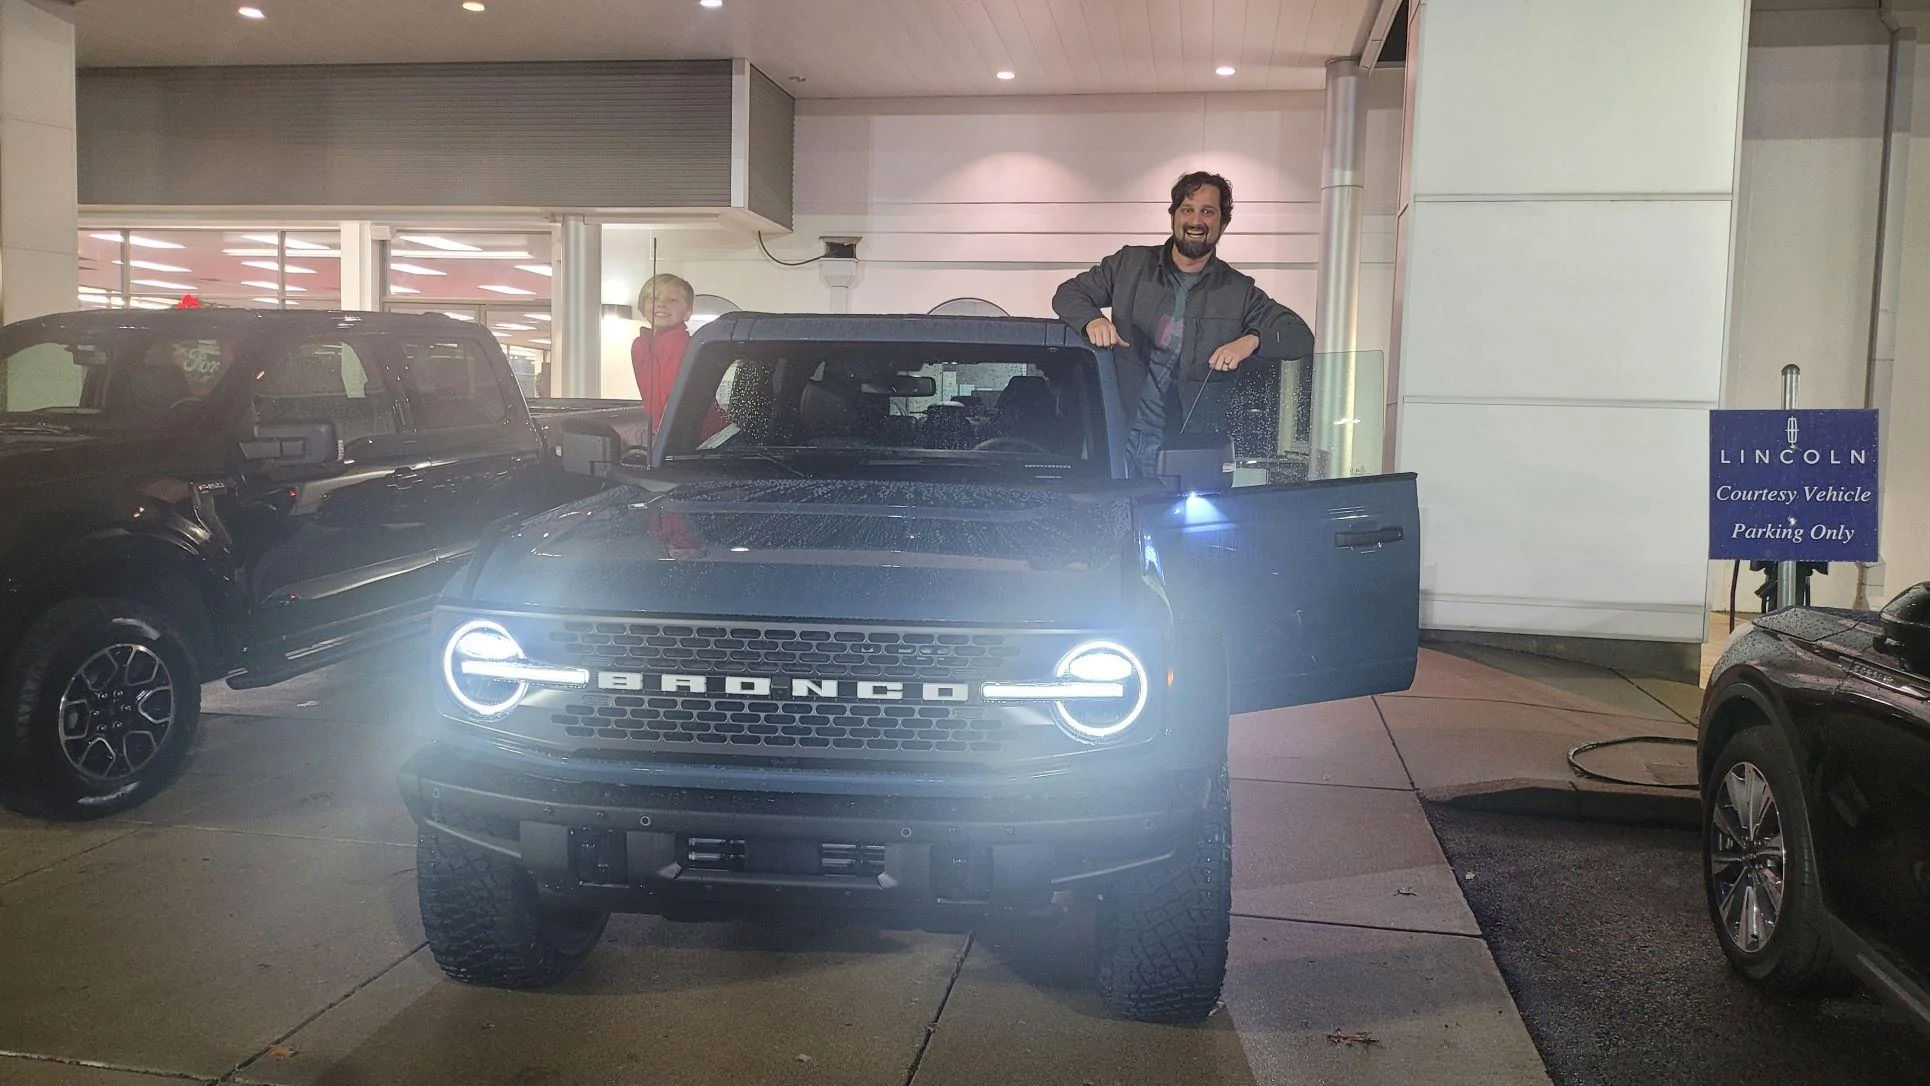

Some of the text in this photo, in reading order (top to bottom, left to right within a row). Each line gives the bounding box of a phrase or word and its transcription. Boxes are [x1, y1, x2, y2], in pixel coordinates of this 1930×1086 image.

[1720, 449, 1866, 464] LINCOLN
[1716, 485, 1871, 504] Courtesy Vehicle
[1732, 523, 1855, 544] Parking Only
[598, 671, 969, 700] BRONCO
